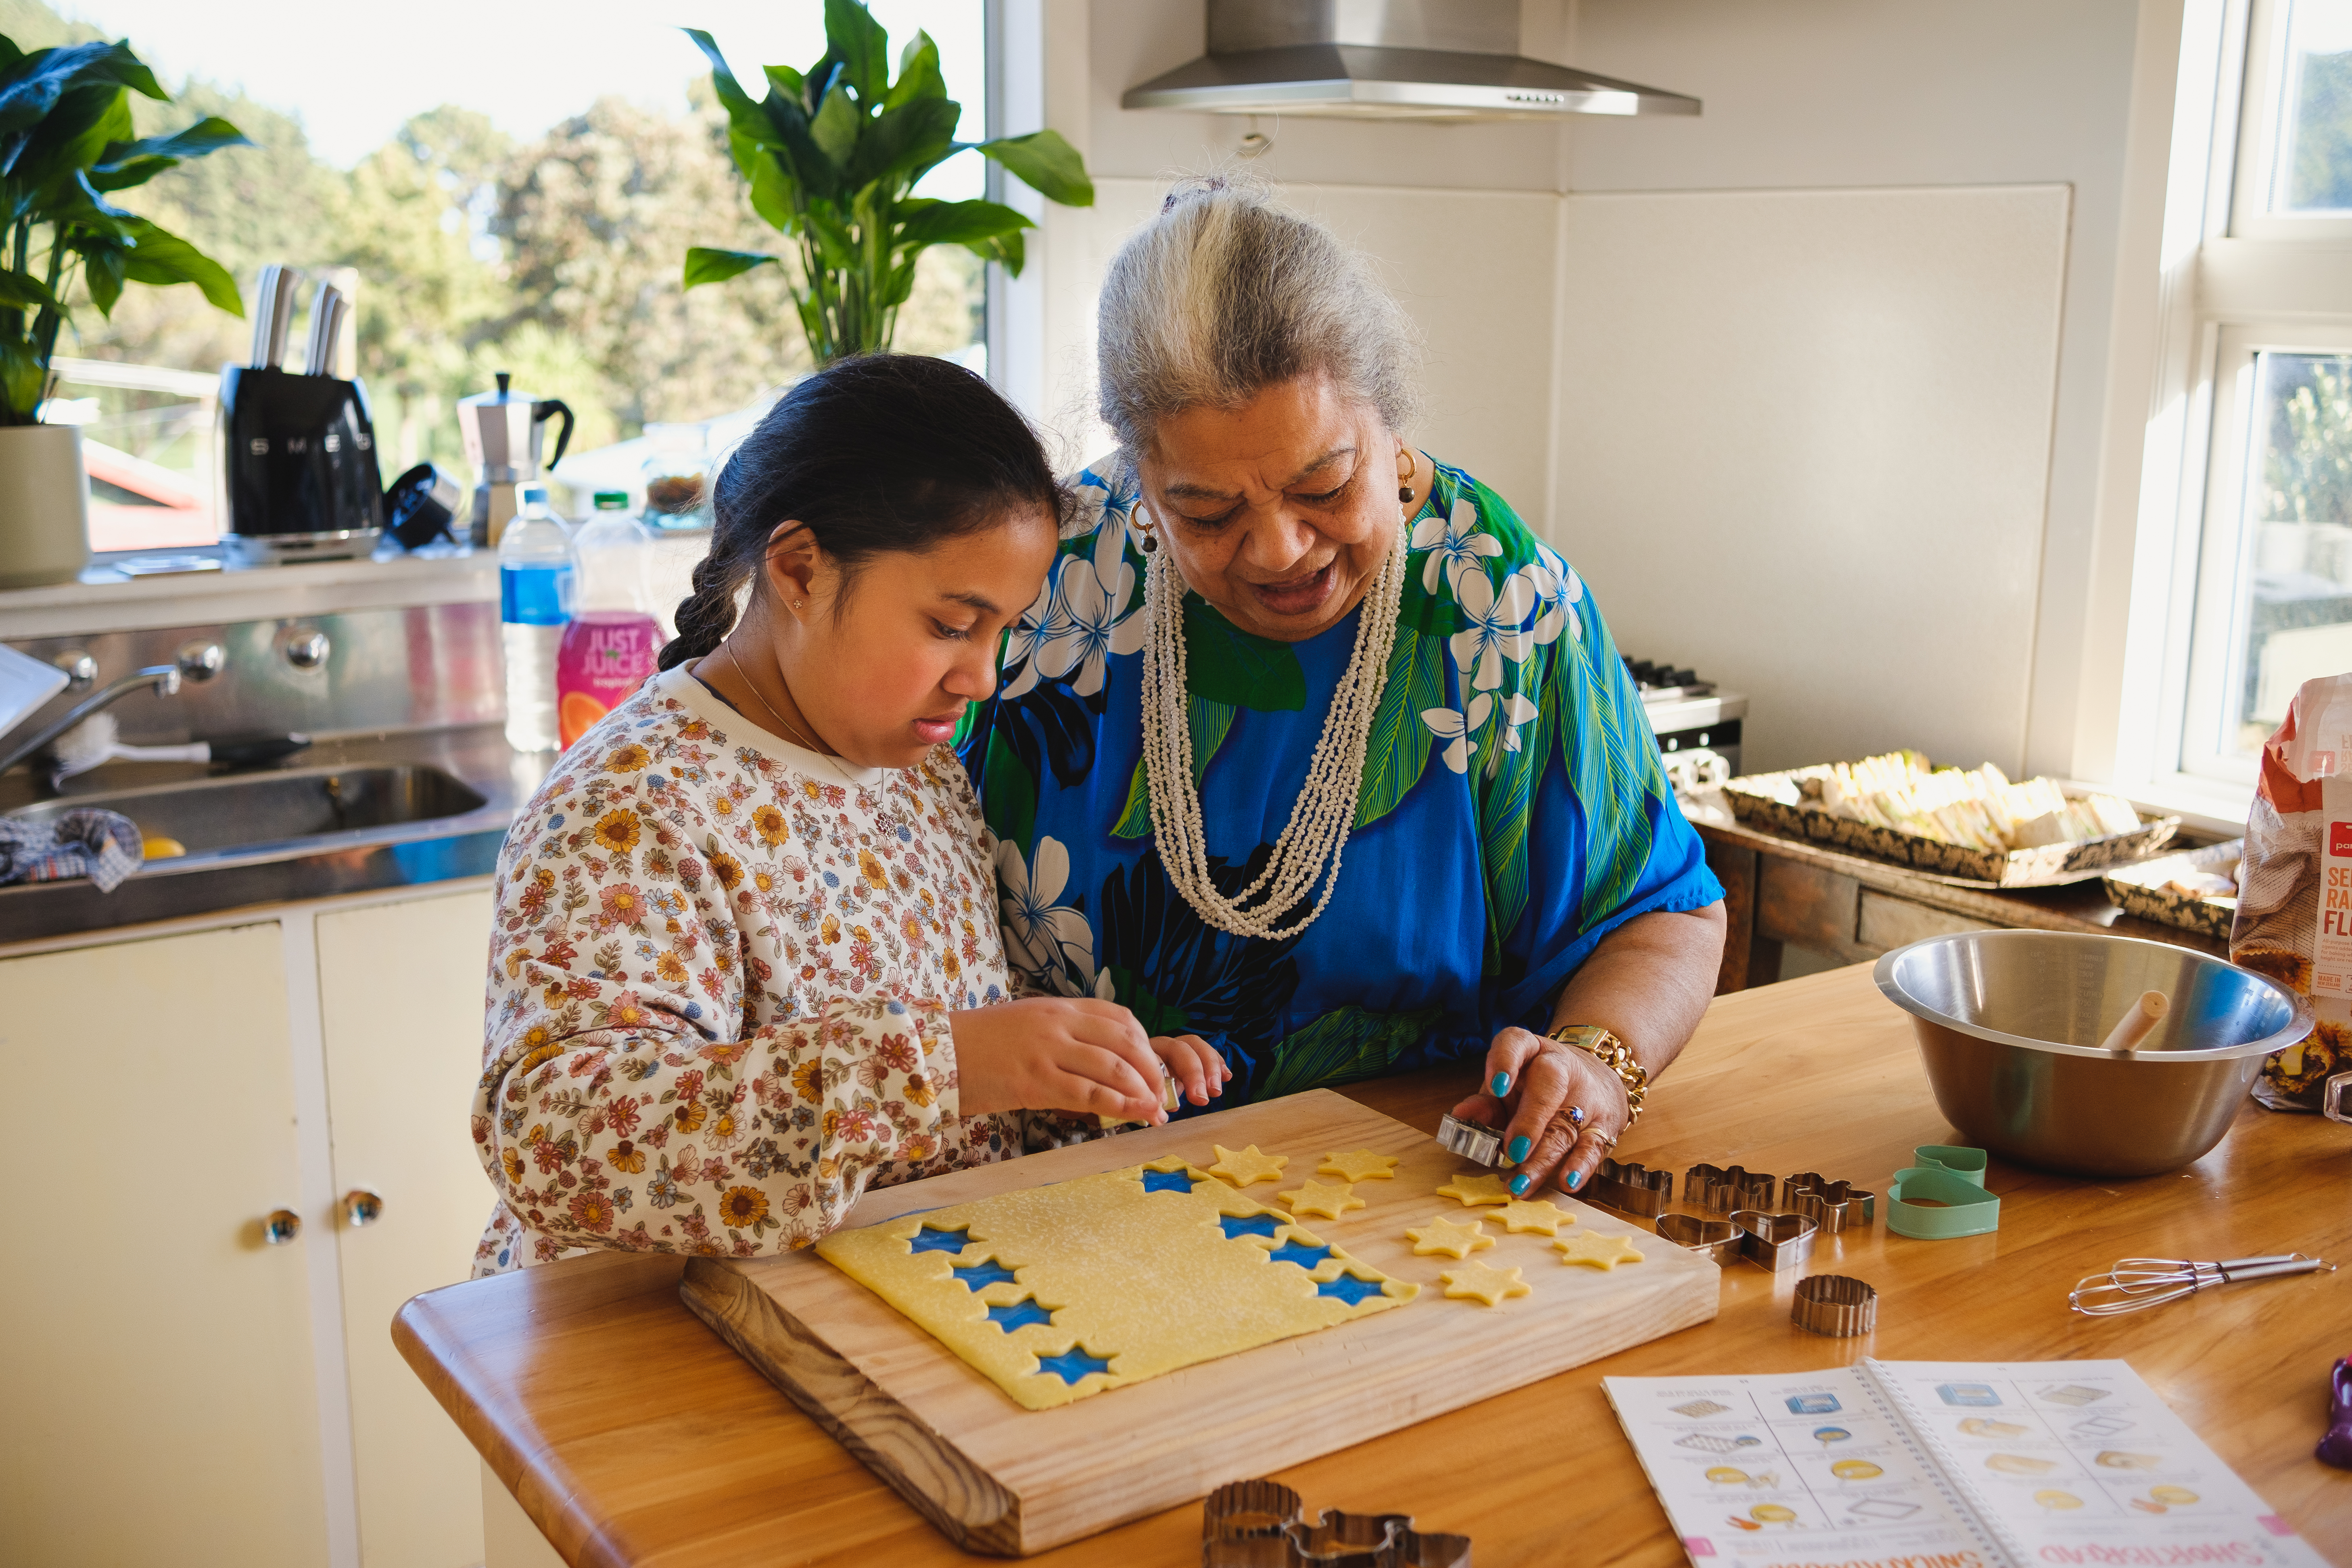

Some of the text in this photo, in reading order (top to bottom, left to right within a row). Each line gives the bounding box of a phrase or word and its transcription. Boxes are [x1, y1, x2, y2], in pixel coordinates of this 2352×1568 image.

[588, 628, 640, 651] JUST
[581, 652, 642, 675] JUICE
[2038, 1541, 2264, 1566] SHORTBREAD
